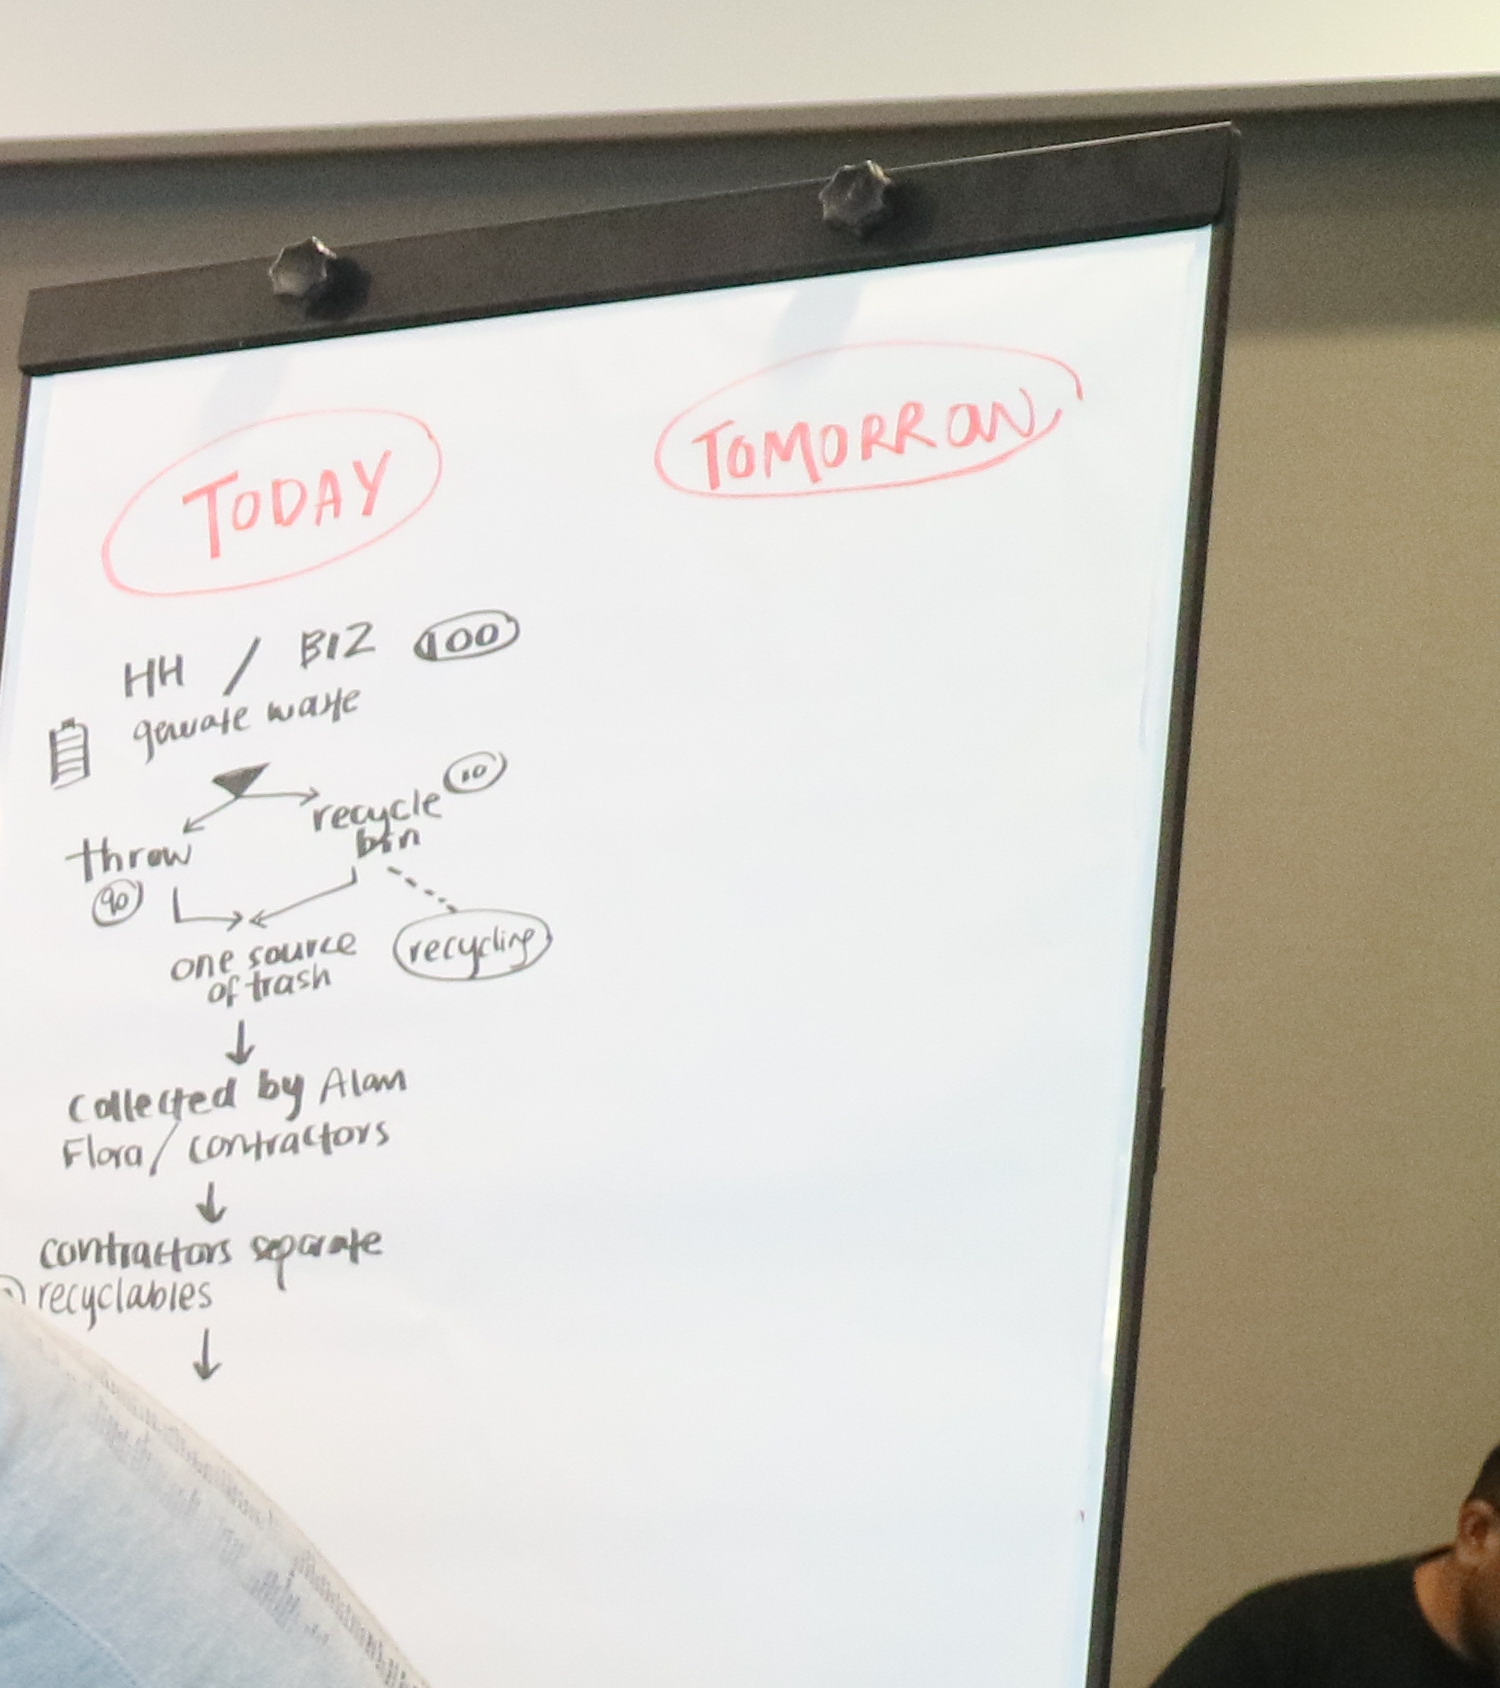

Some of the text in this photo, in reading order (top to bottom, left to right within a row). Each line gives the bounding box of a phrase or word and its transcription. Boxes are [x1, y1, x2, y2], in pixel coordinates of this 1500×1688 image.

[182, 447, 394, 560] TODAY
[124, 653, 185, 699] HH
[300, 621, 377, 669] BIZ
[312, 788, 443, 841] recycle
[64, 835, 192, 884] throw
[356, 827, 421, 859] bin
[170, 931, 358, 982] one source
[408, 925, 536, 980] recycling
[206, 963, 332, 1008] of trash
[257, 1067, 306, 1123] by
[188, 1120, 391, 1165] contractors
[39, 1227, 384, 1292] contractors separate
[37, 1276, 215, 1332] recyclables
